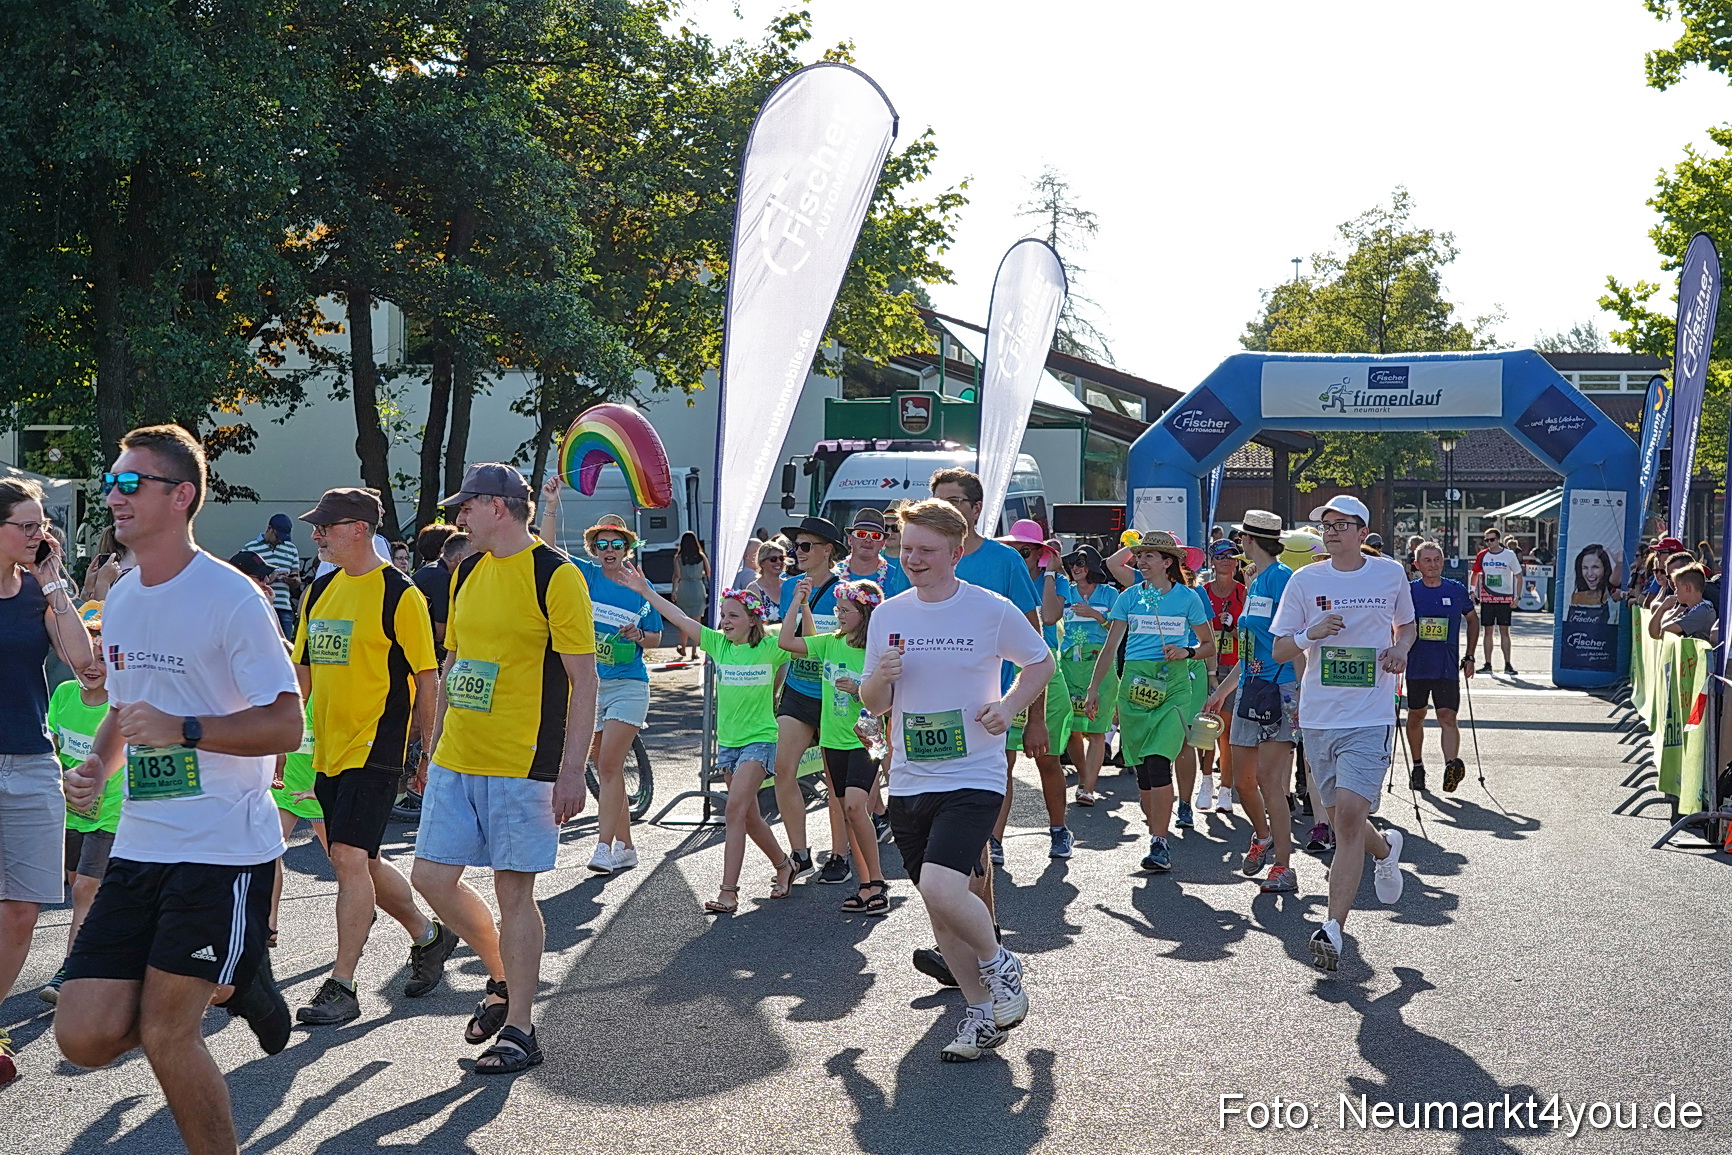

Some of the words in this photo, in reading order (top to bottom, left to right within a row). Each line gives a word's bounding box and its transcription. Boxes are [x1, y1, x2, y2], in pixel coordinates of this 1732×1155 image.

[782, 104, 849, 248] Fischer
[815, 125, 864, 240] AUTOMOBILE
[1012, 267, 1046, 362] Fischer
[1687, 260, 1710, 360] Fischer
[1698, 275, 1714, 356] AUTOMOBILE
[1376, 373, 1407, 381] Fischer
[1354, 389, 1443, 407] firmenlauf
[1182, 416, 1230, 429] Fischer
[1544, 416, 1557, 424] das
[734, 328, 813, 532] www.fischer-automobile.de
[839, 478, 879, 488] abavent
[1334, 598, 1387, 606] SCHWARZ
[1426, 625, 1443, 634] 973
[312, 634, 342, 650] 1276
[907, 638, 975, 646] SCHWARZ
[1572, 637, 1607, 647] Fischer
[735, 669, 767, 677] Grundschule
[796, 659, 819, 672] 1436
[1331, 660, 1365, 675] 1361
[453, 675, 485, 694] 1269
[482, 682, 492, 705] 2022
[1134, 686, 1159, 701] 1442
[68, 736, 81, 747] Freie
[915, 729, 948, 746] 180
[954, 729, 964, 752] 2022
[138, 755, 176, 778] 183
[184, 755, 197, 787] 2022
[158, 779, 183, 787] Marco
[191, 953, 217, 962] adidas
